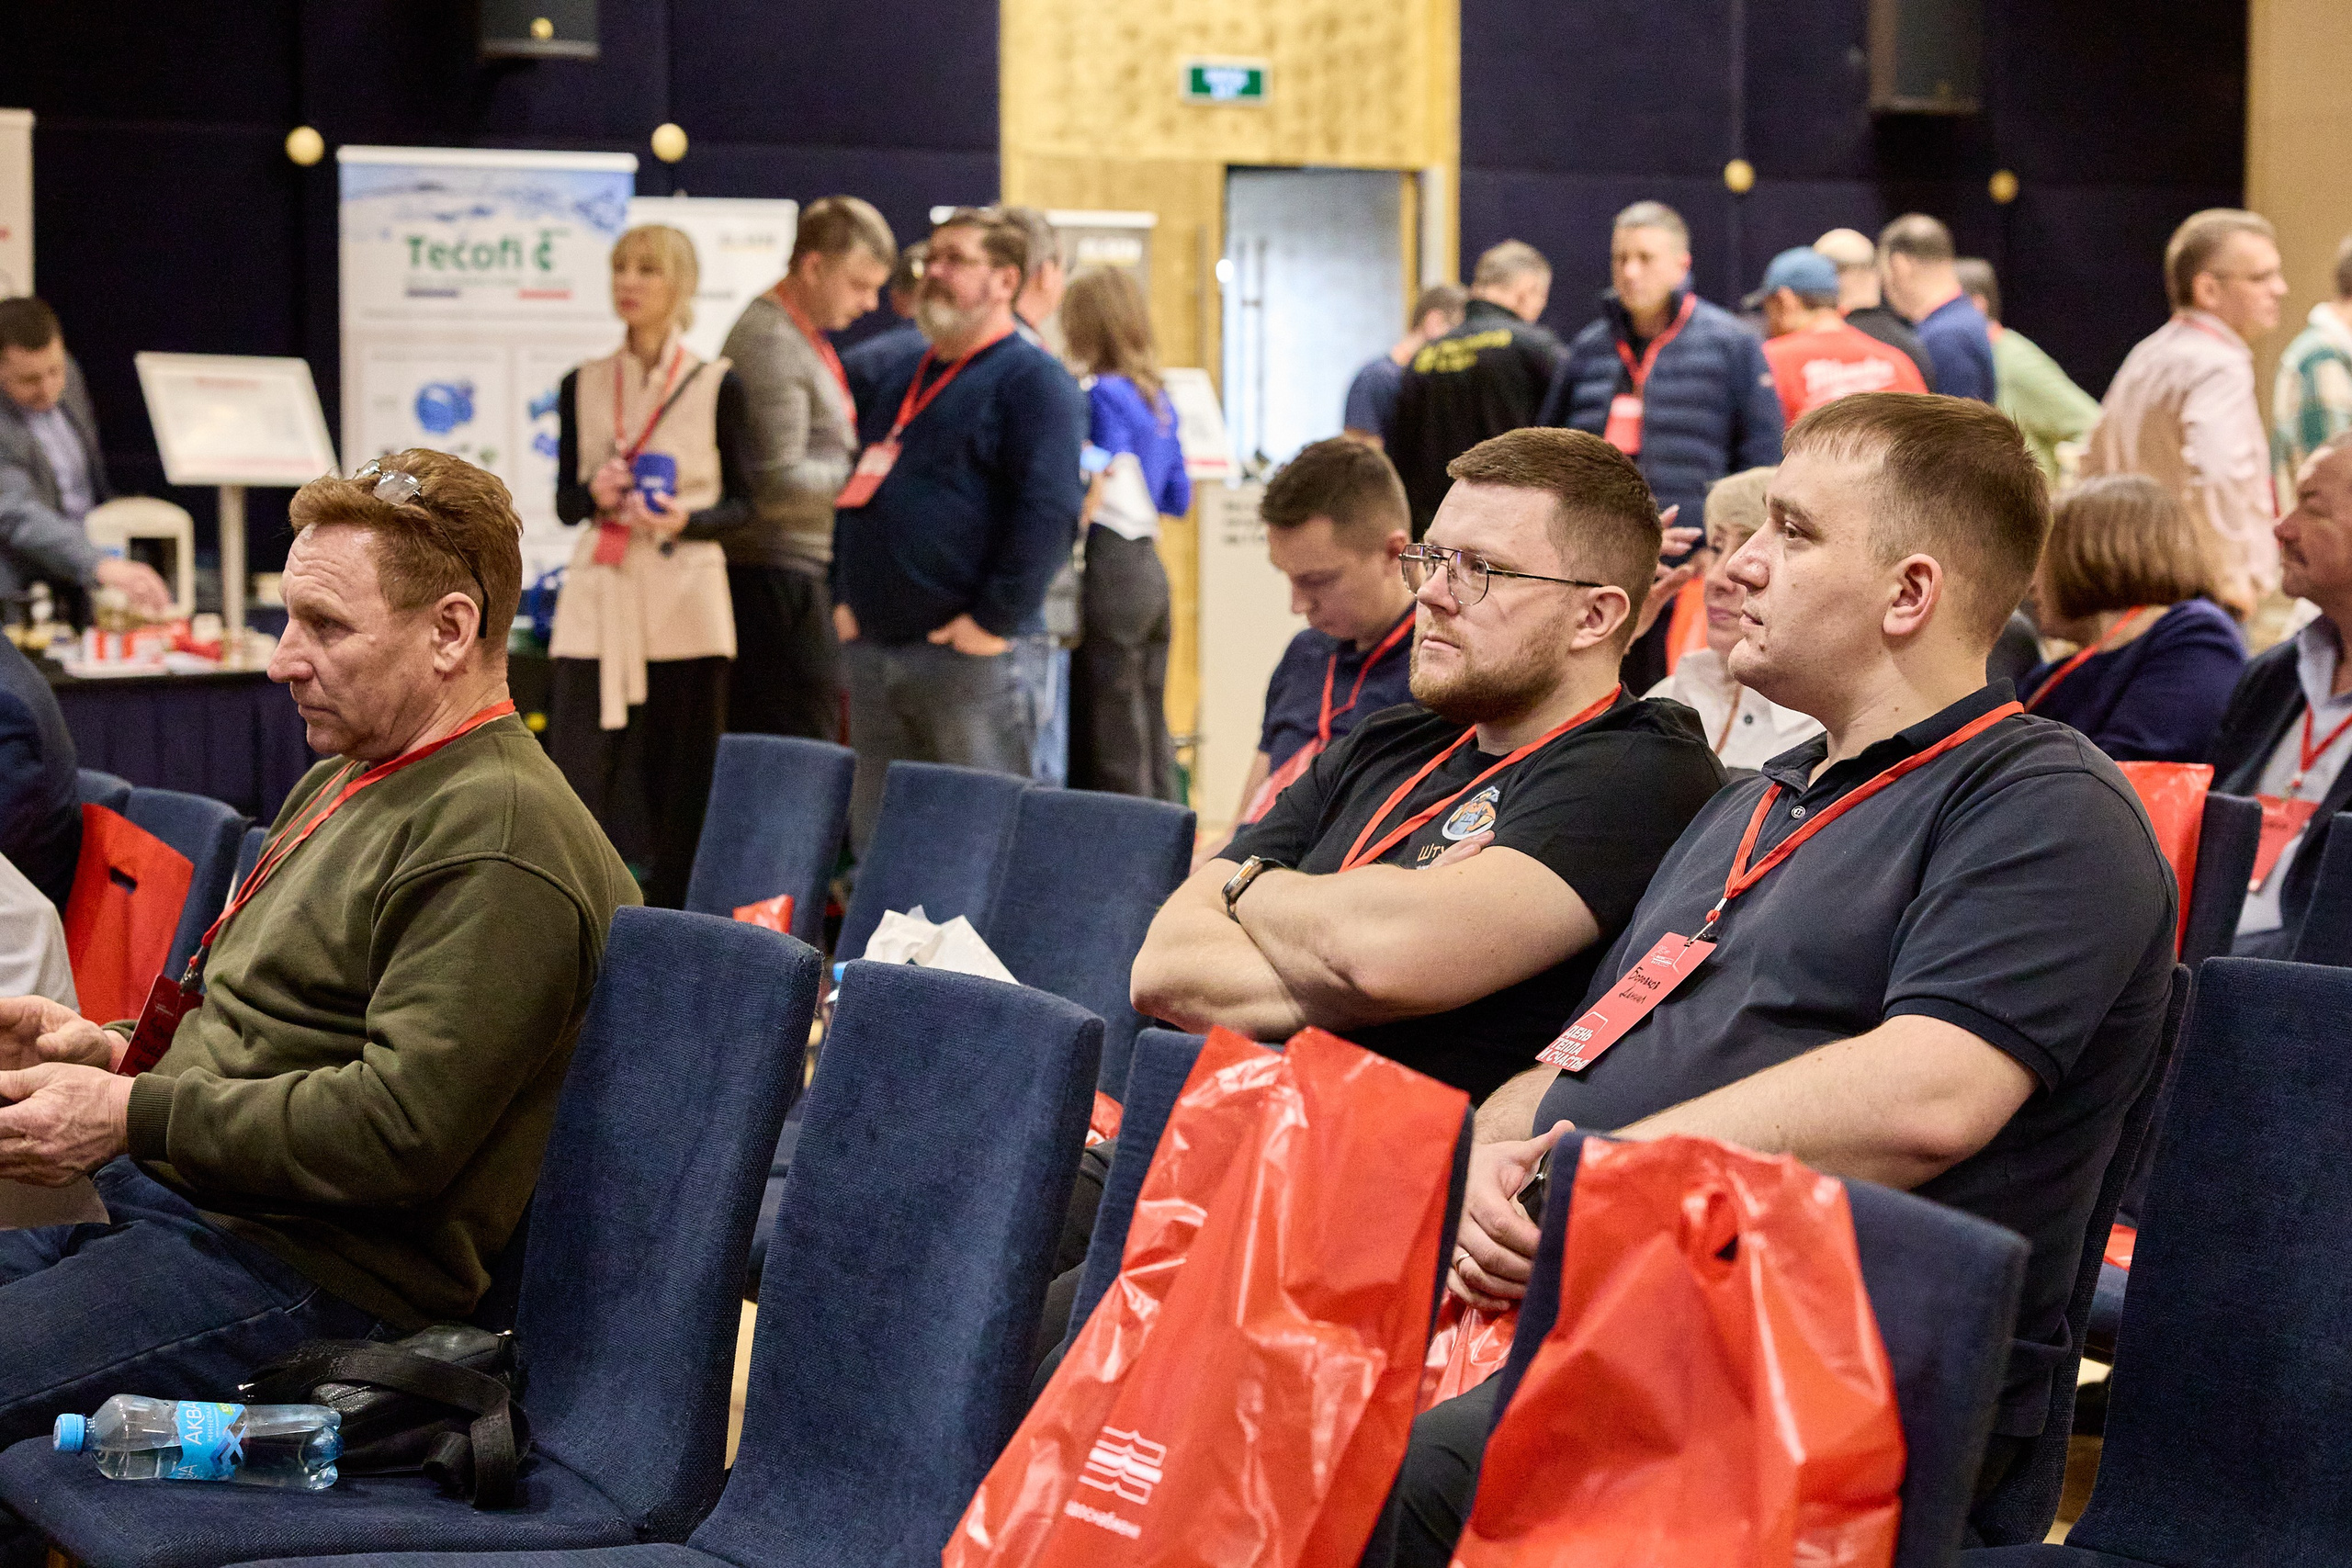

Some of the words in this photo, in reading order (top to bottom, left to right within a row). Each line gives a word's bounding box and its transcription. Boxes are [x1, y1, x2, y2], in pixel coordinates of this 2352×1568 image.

[1561, 1024, 1594, 1042] ДЕНЬ
[1537, 1047, 1554, 1060] И
[1550, 1037, 1587, 1056] ТЕПЛА
[1545, 1050, 1589, 1071] СЧАСТЬЯ
[181, 1401, 206, 1446] АКВА
